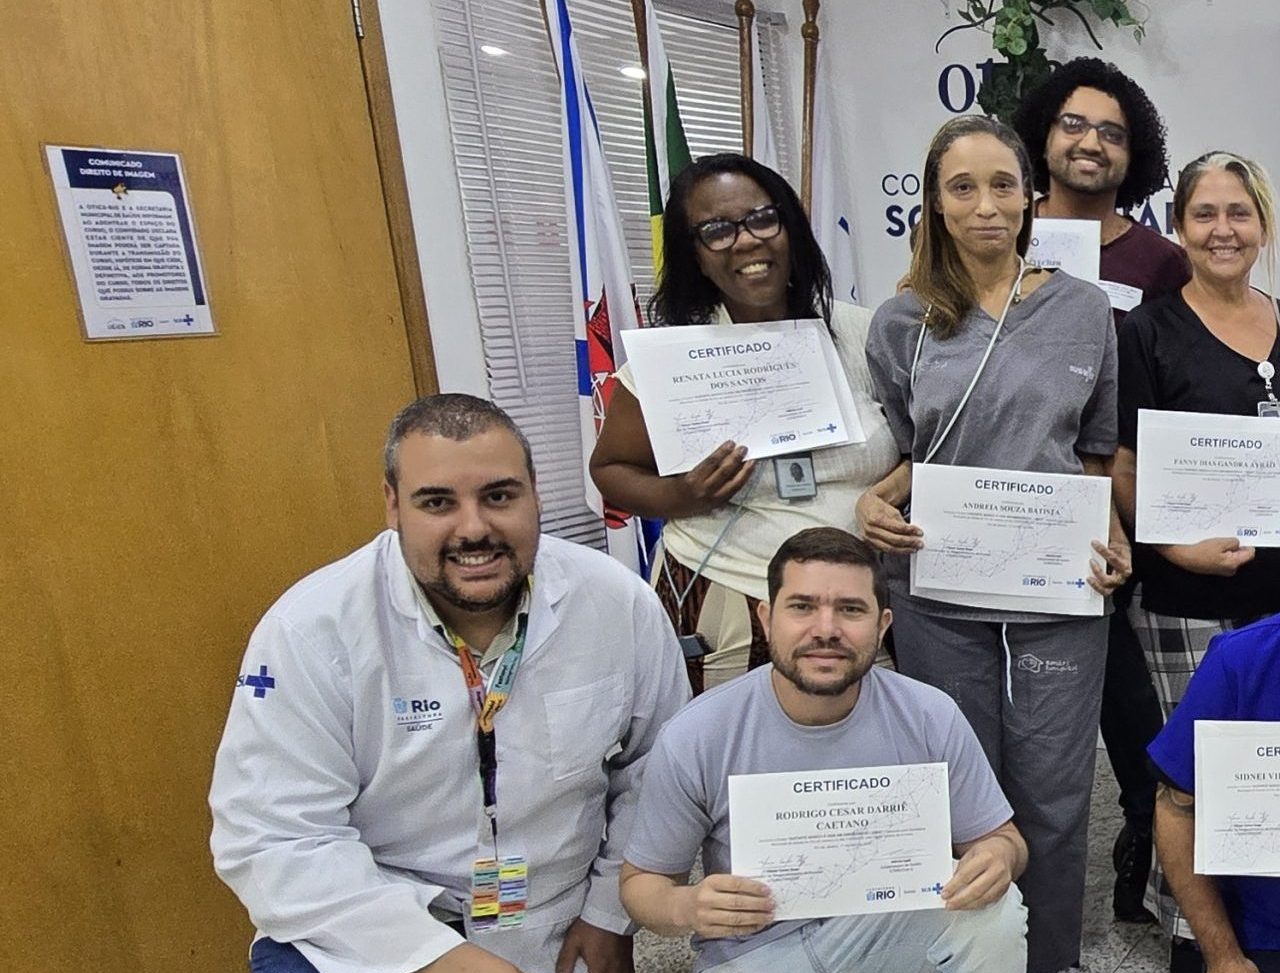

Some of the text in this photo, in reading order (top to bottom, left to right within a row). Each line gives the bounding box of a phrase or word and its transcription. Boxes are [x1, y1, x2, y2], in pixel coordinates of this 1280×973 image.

[80, 168, 112, 176] DIREITO
[688, 341, 772, 360] CERTIFICADO
[1190, 437, 1263, 449] CERTIFICADO
[975, 479, 1054, 495] CERTIFICADO
[412, 699, 441, 713] Rio
[793, 776, 891, 793] CERTIFICADO
[776, 809, 827, 821] RODRIGO
[829, 807, 864, 817] CESAR
[816, 819, 869, 830] CAETANO
[876, 890, 895, 900] RIO
